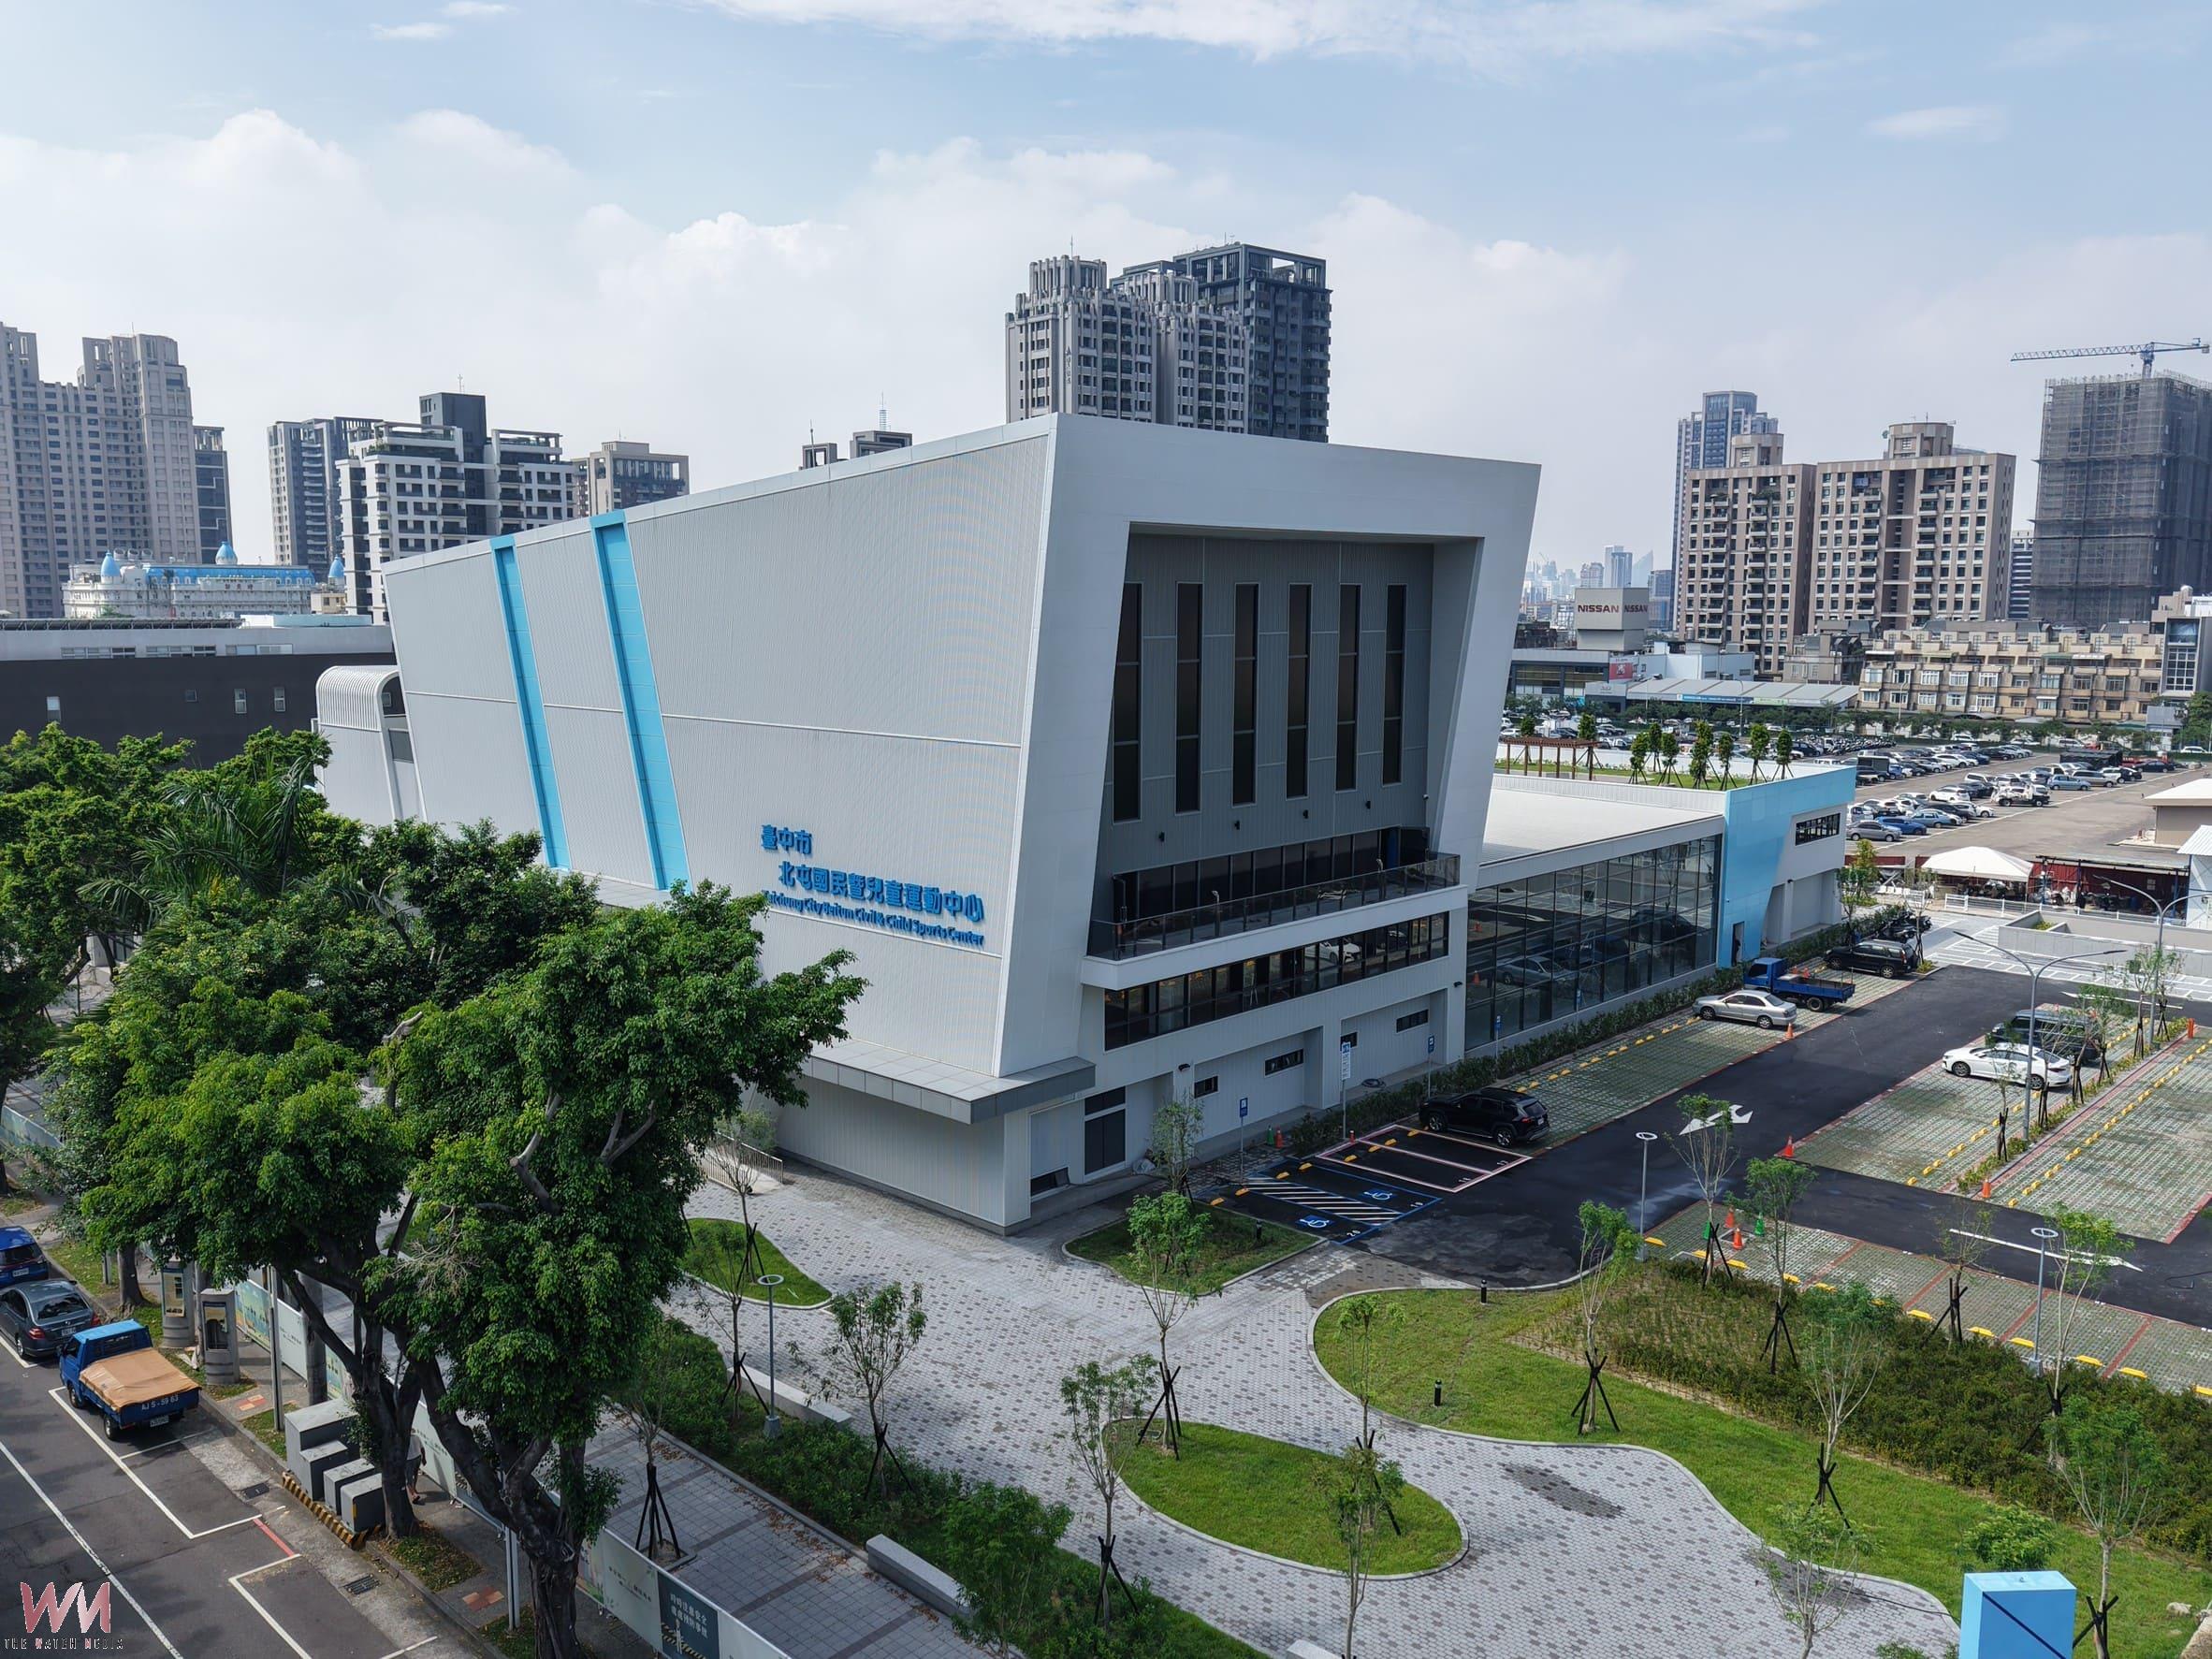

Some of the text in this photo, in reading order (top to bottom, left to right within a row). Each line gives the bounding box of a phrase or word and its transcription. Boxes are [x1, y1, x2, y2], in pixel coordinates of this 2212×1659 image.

[1578, 604, 1620, 613] NISSAN
[1623, 604, 1649, 613] NISSAN
[761, 824, 812, 854] 臺中市
[779, 861, 983, 923] 北屯國民暨兒童運動中心
[804, 897, 823, 915] City
[886, 914, 913, 932] Child
[913, 919, 947, 937] Sports
[947, 926, 984, 945] Center
